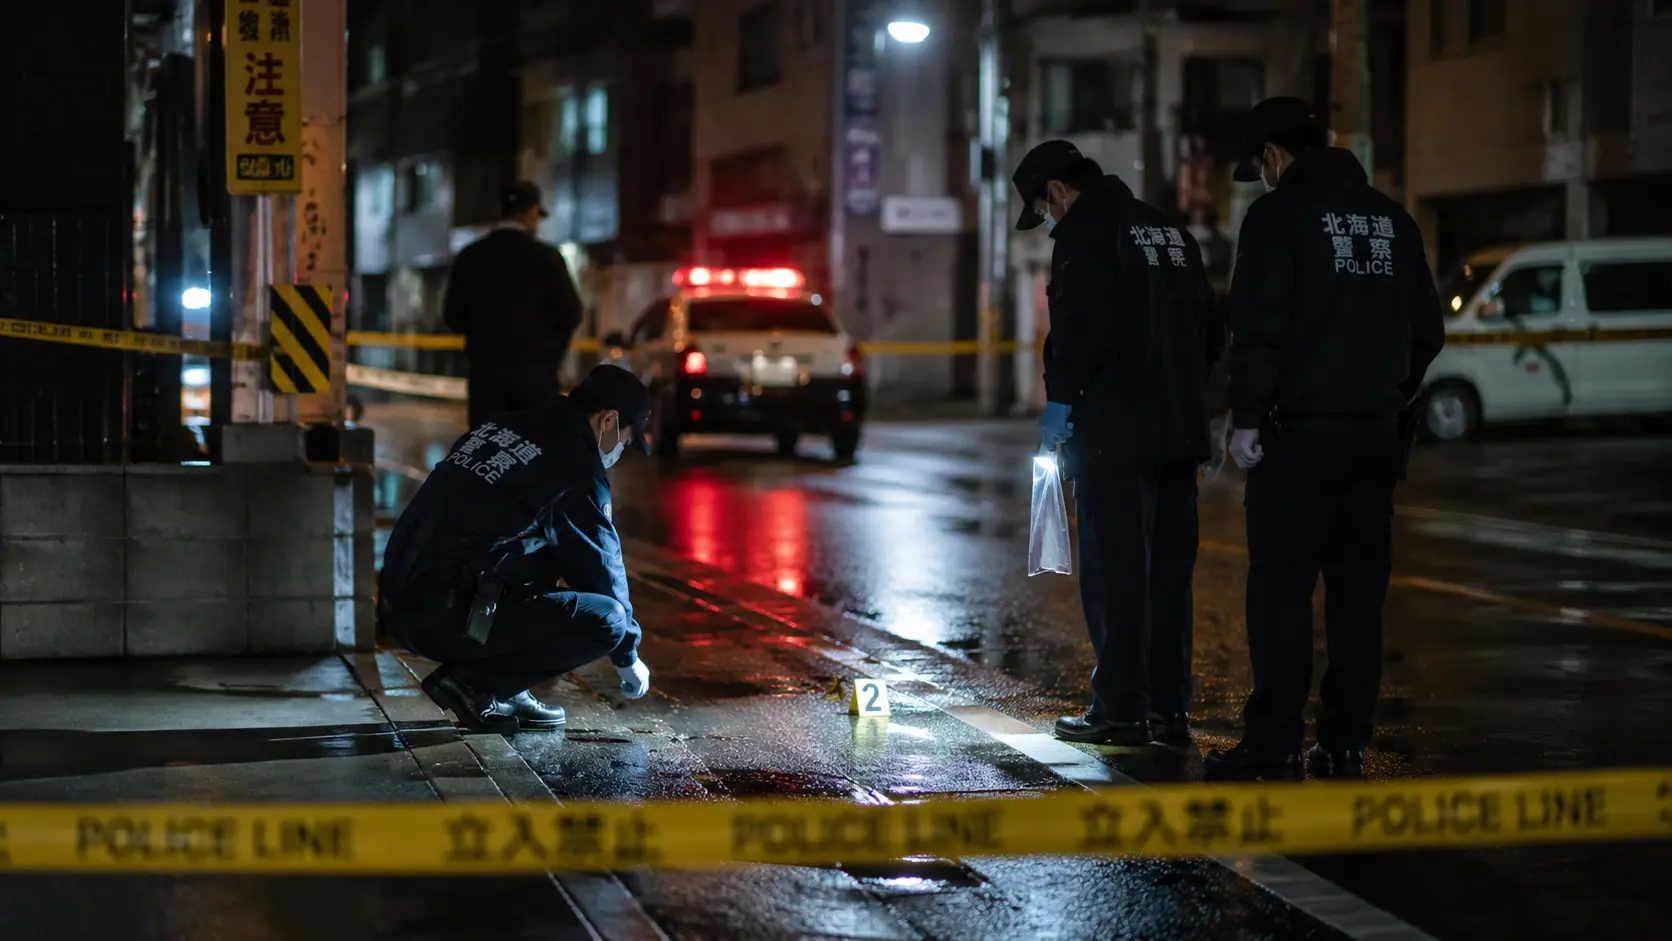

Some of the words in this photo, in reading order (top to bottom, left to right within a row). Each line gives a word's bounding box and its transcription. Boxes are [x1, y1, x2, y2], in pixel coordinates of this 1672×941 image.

[244, 52, 285, 146] 注意
[1129, 225, 1186, 248] 北海道
[1321, 212, 1396, 239] 北海道
[1332, 236, 1393, 261] 警察
[1335, 258, 1394, 277] POLICE
[470, 421, 543, 466] 北海道
[446, 451, 502, 485] POLICE
[862, 682, 882, 712] 2
[731, 811, 886, 857] POLICE
[904, 806, 1005, 853] LINE
[1078, 795, 1285, 850] 立入禁止
[1351, 789, 1501, 838] POLICE
[1517, 783, 1607, 833] LINE
[75, 815, 235, 862] POLICE
[251, 816, 356, 862] LINE
[441, 811, 664, 866] 立入禁止
